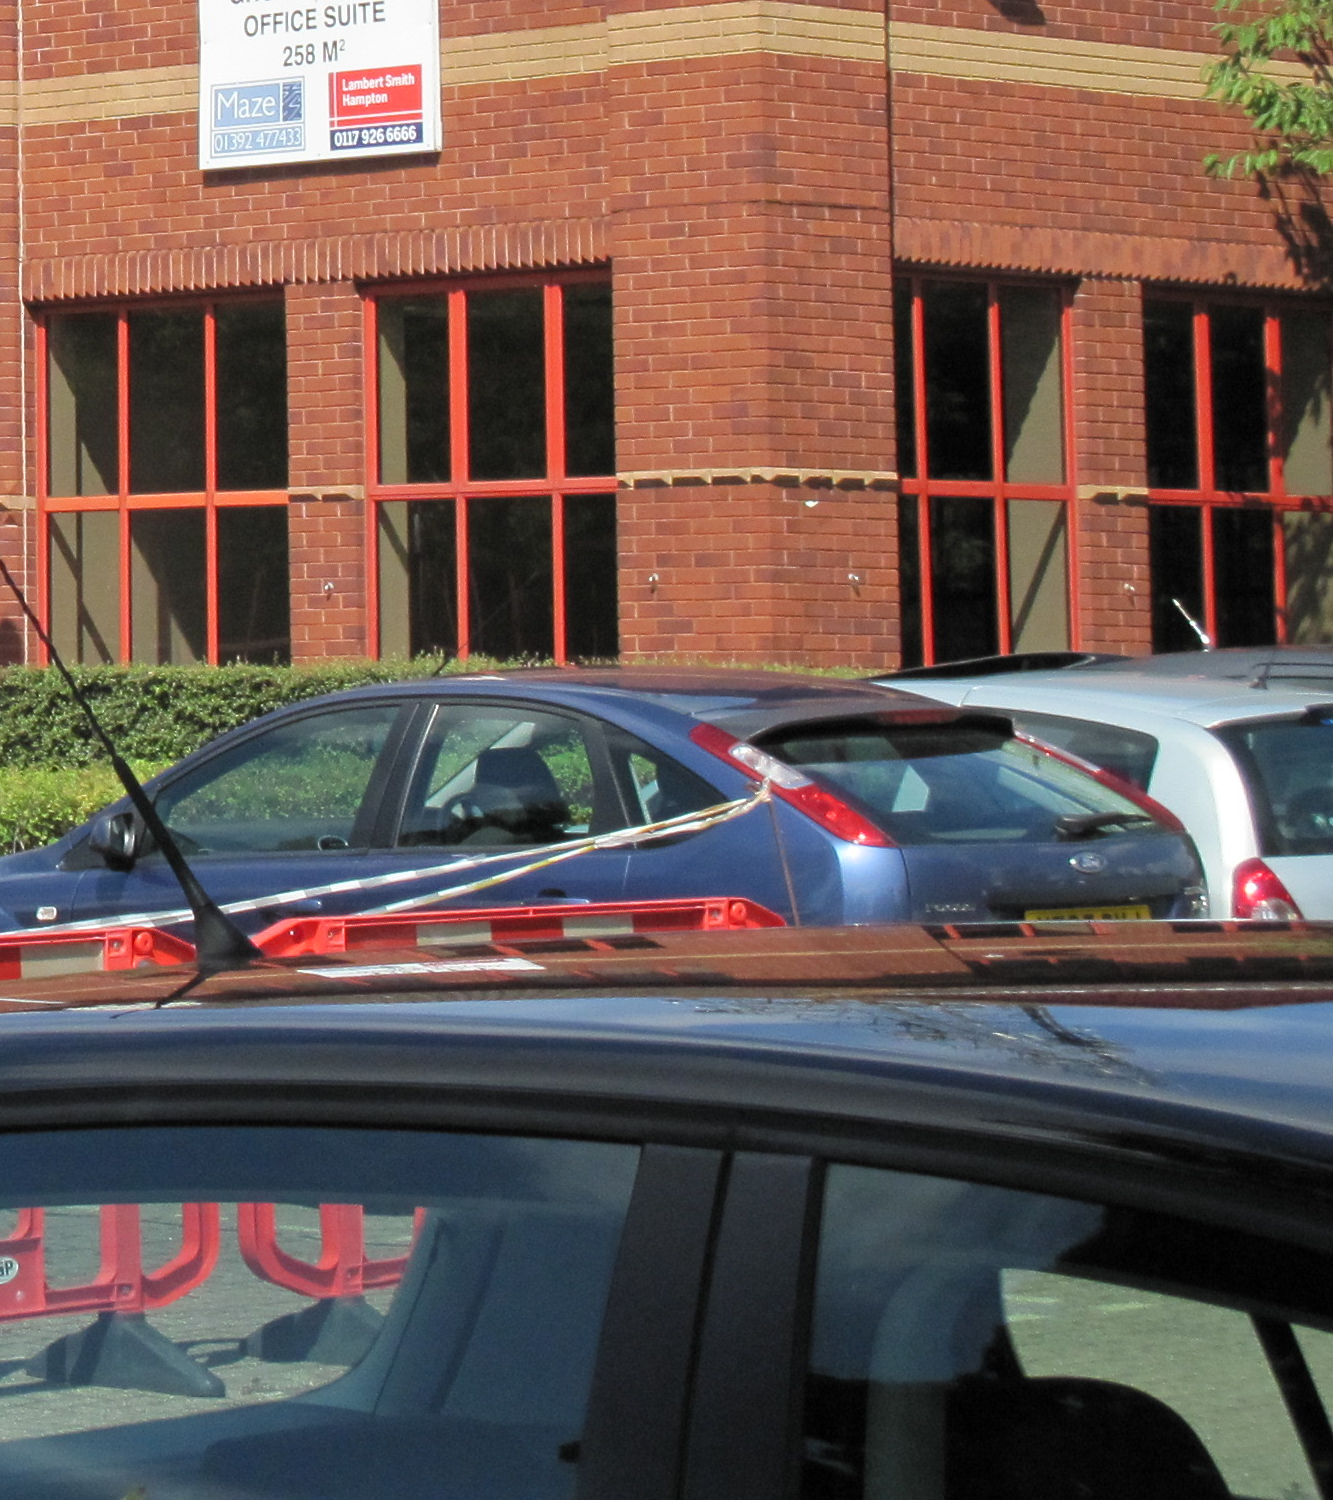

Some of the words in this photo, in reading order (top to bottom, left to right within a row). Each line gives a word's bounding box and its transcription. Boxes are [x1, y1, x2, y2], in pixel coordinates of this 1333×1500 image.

[244, 8, 318, 37] OFFICE
[324, 1, 386, 28] SUITE
[283, 43, 316, 67] 258
[342, 76, 383, 91] Lambert
[385, 73, 415, 87] Smith
[217, 91, 276, 120] Maze
[342, 93, 388, 107] Hampton
[215, 133, 252, 151] 01392
[256, 128, 301, 147] 477433
[334, 130, 359, 147] 0117
[362, 128, 384, 145] 926
[386, 125, 417, 142] 6666
